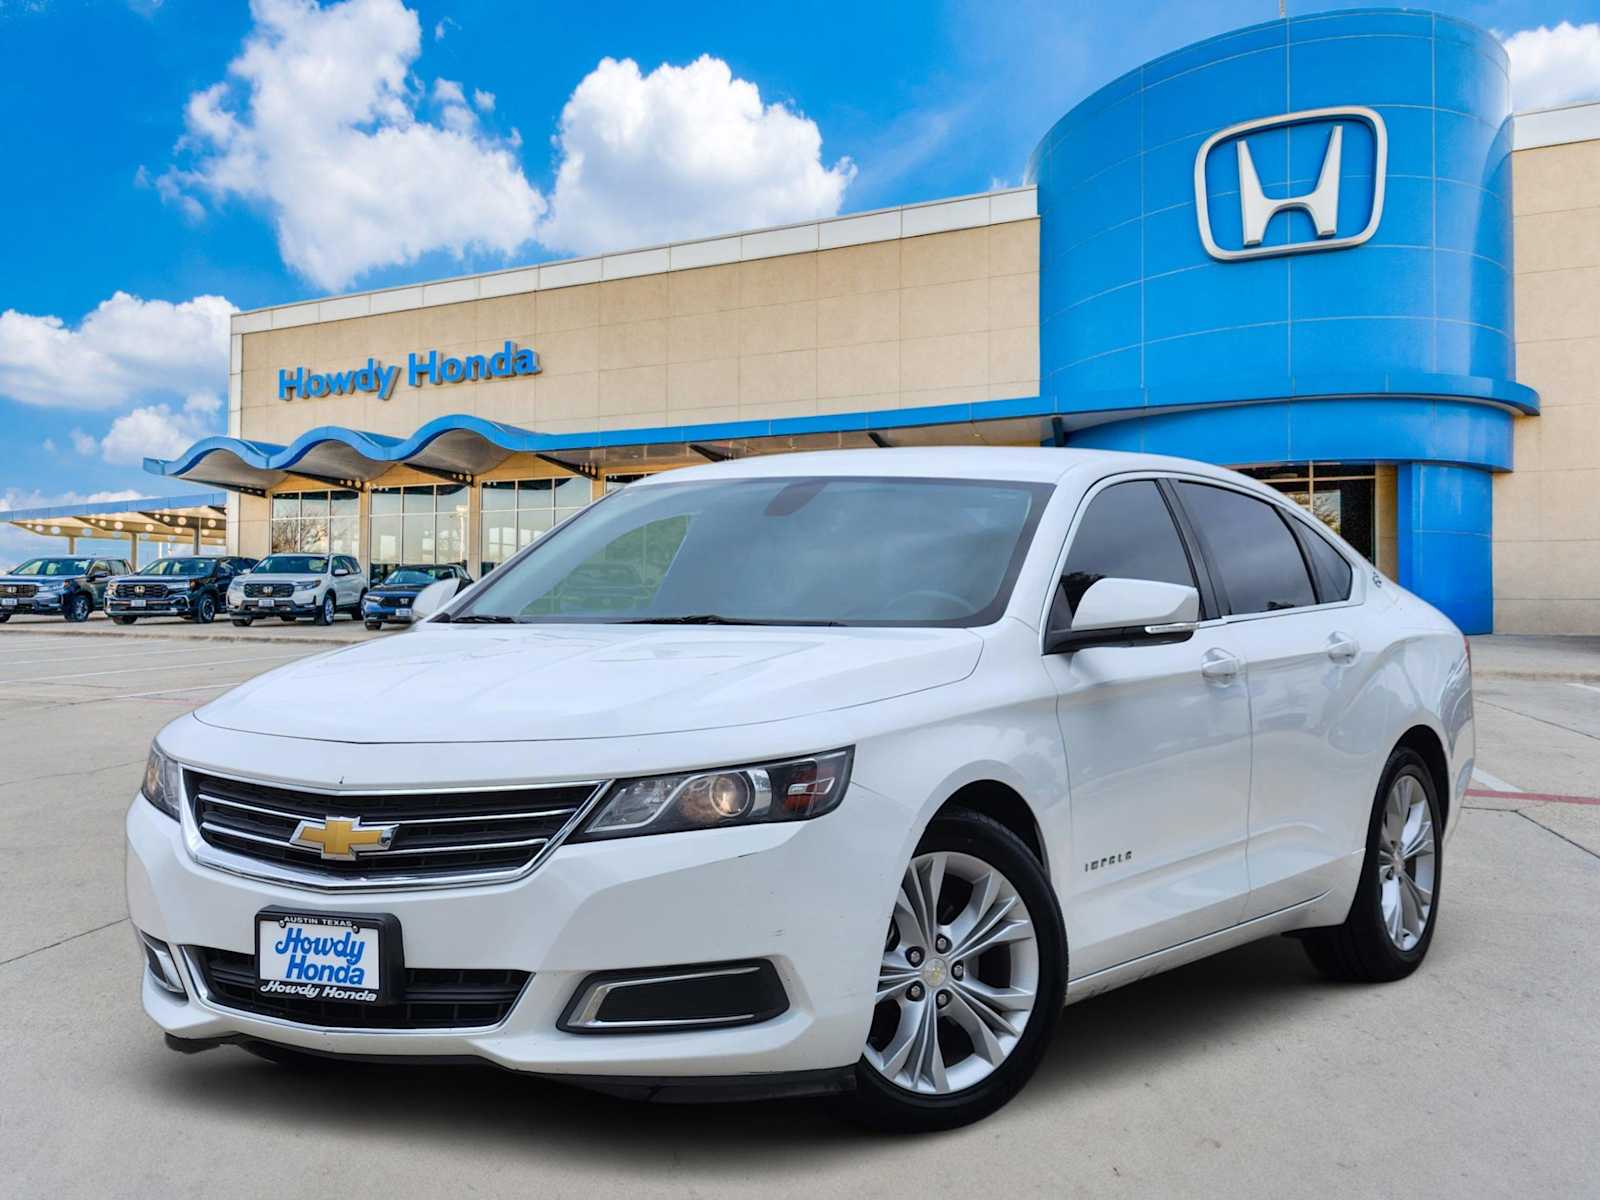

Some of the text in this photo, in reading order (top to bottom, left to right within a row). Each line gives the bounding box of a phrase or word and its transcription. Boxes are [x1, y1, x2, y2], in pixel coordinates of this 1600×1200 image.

[278, 341, 542, 400] Howdy Honda
[284, 916, 353, 927] AUSTIN TEXAS
[275, 927, 366, 966] Howdy
[286, 955, 366, 985] Honda
[260, 980, 378, 1002] Howdy Honda
